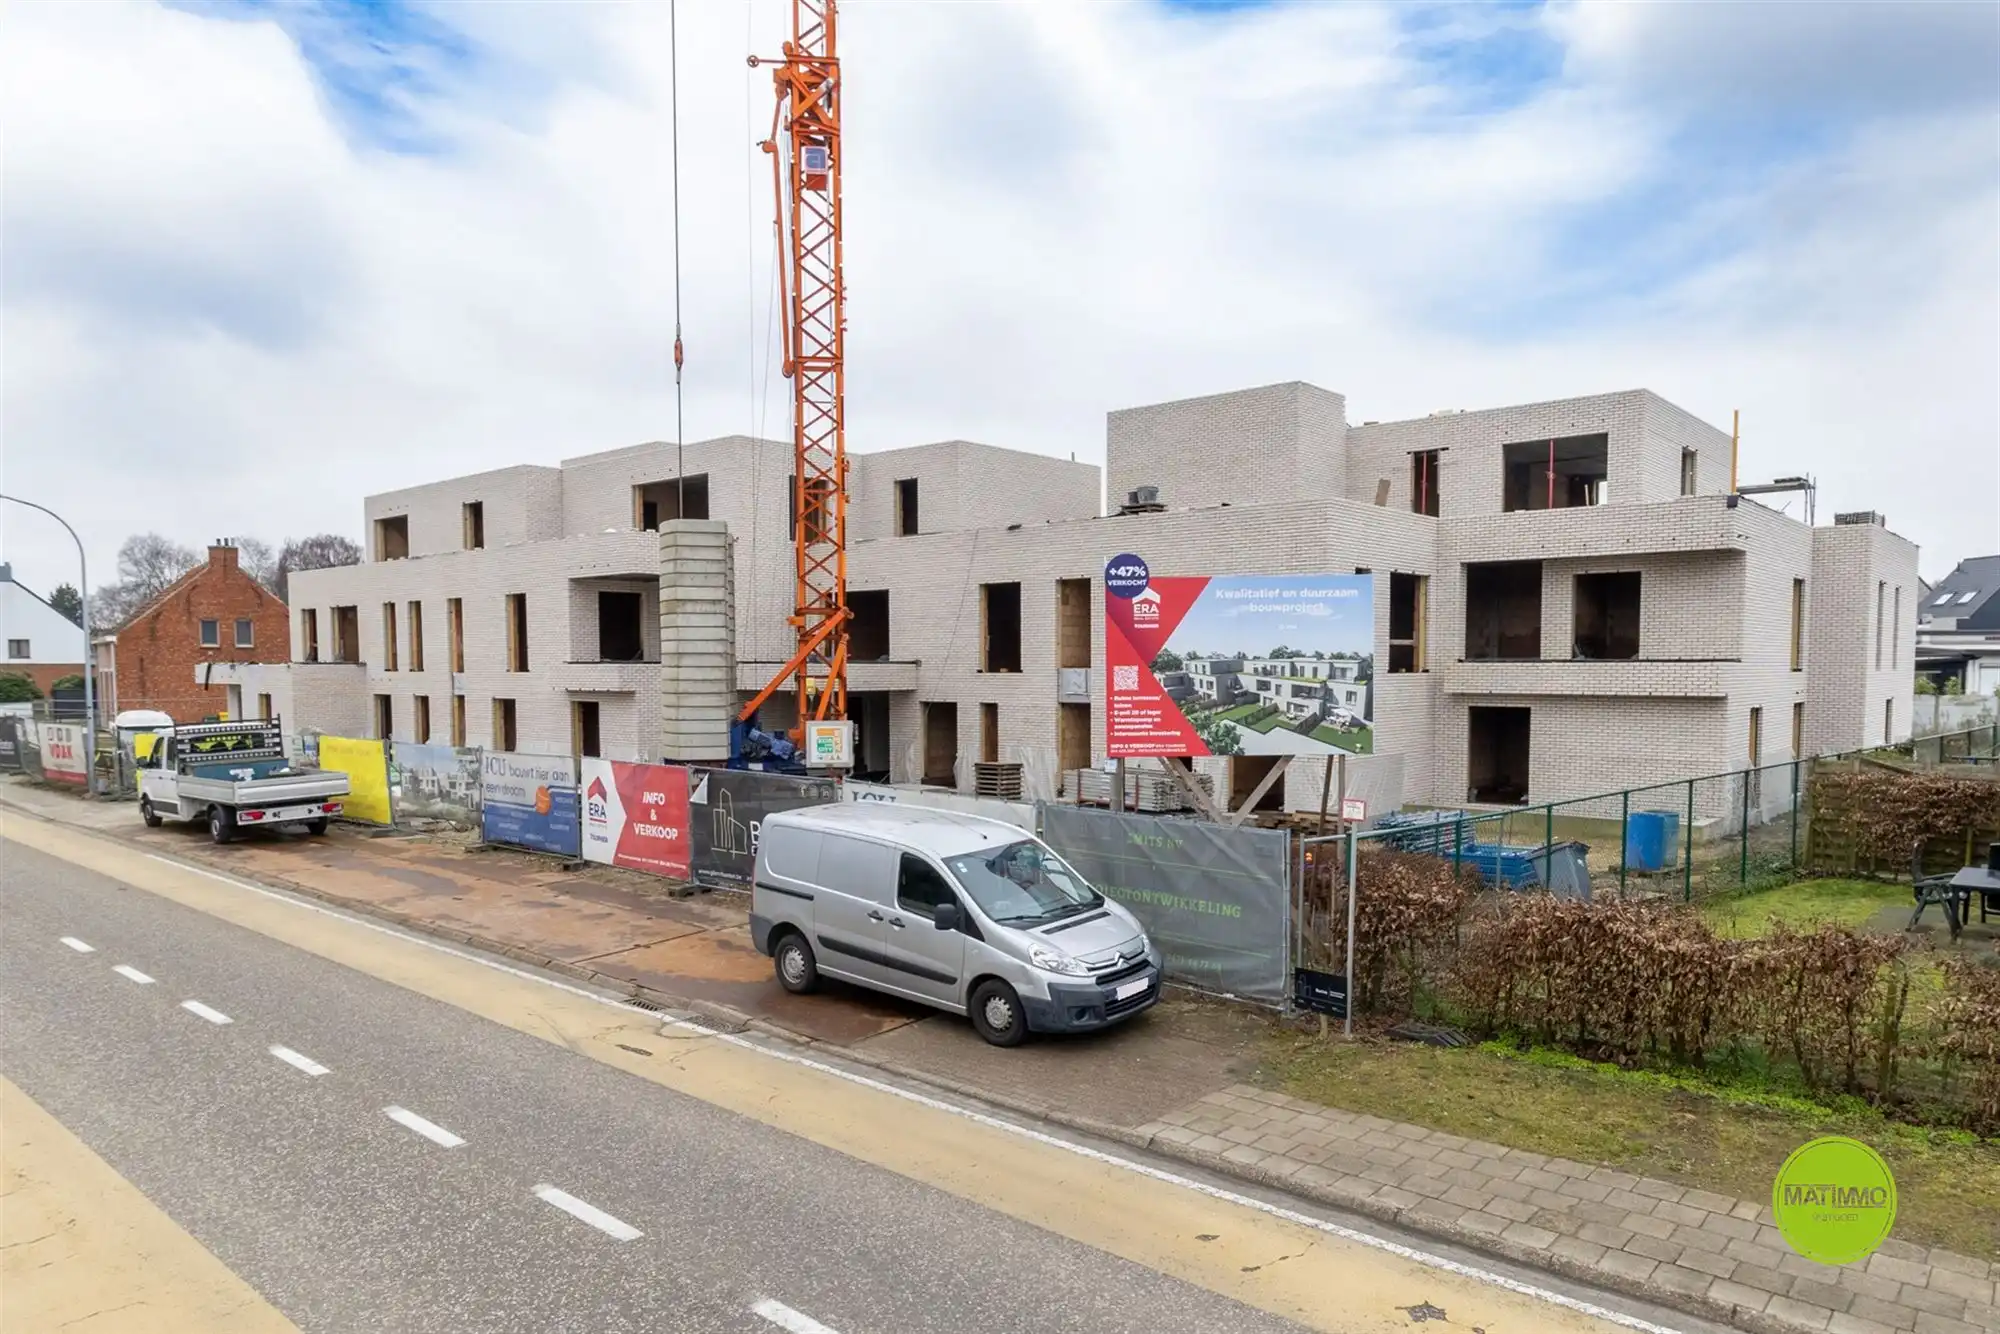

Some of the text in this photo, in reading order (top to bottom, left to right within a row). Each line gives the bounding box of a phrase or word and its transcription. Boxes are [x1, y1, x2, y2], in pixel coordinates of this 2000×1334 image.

[1109, 566, 1146, 577] +47%
[1216, 588, 1359, 599] Kwalitatief en duurzaam
[1133, 603, 1159, 613] ERA
[1250, 602, 1325, 613] bouwproject
[485, 756, 506, 776] ICU
[508, 764, 534, 779] bouwt
[552, 770, 570, 782] aan
[486, 783, 526, 798] een droom
[642, 791, 666, 806] INFO
[588, 802, 607, 818] ERA
[650, 808, 657, 821] &
[633, 822, 679, 840] VERKOOP
[1093, 883, 1242, 918] OJECTONTWIKKELING
